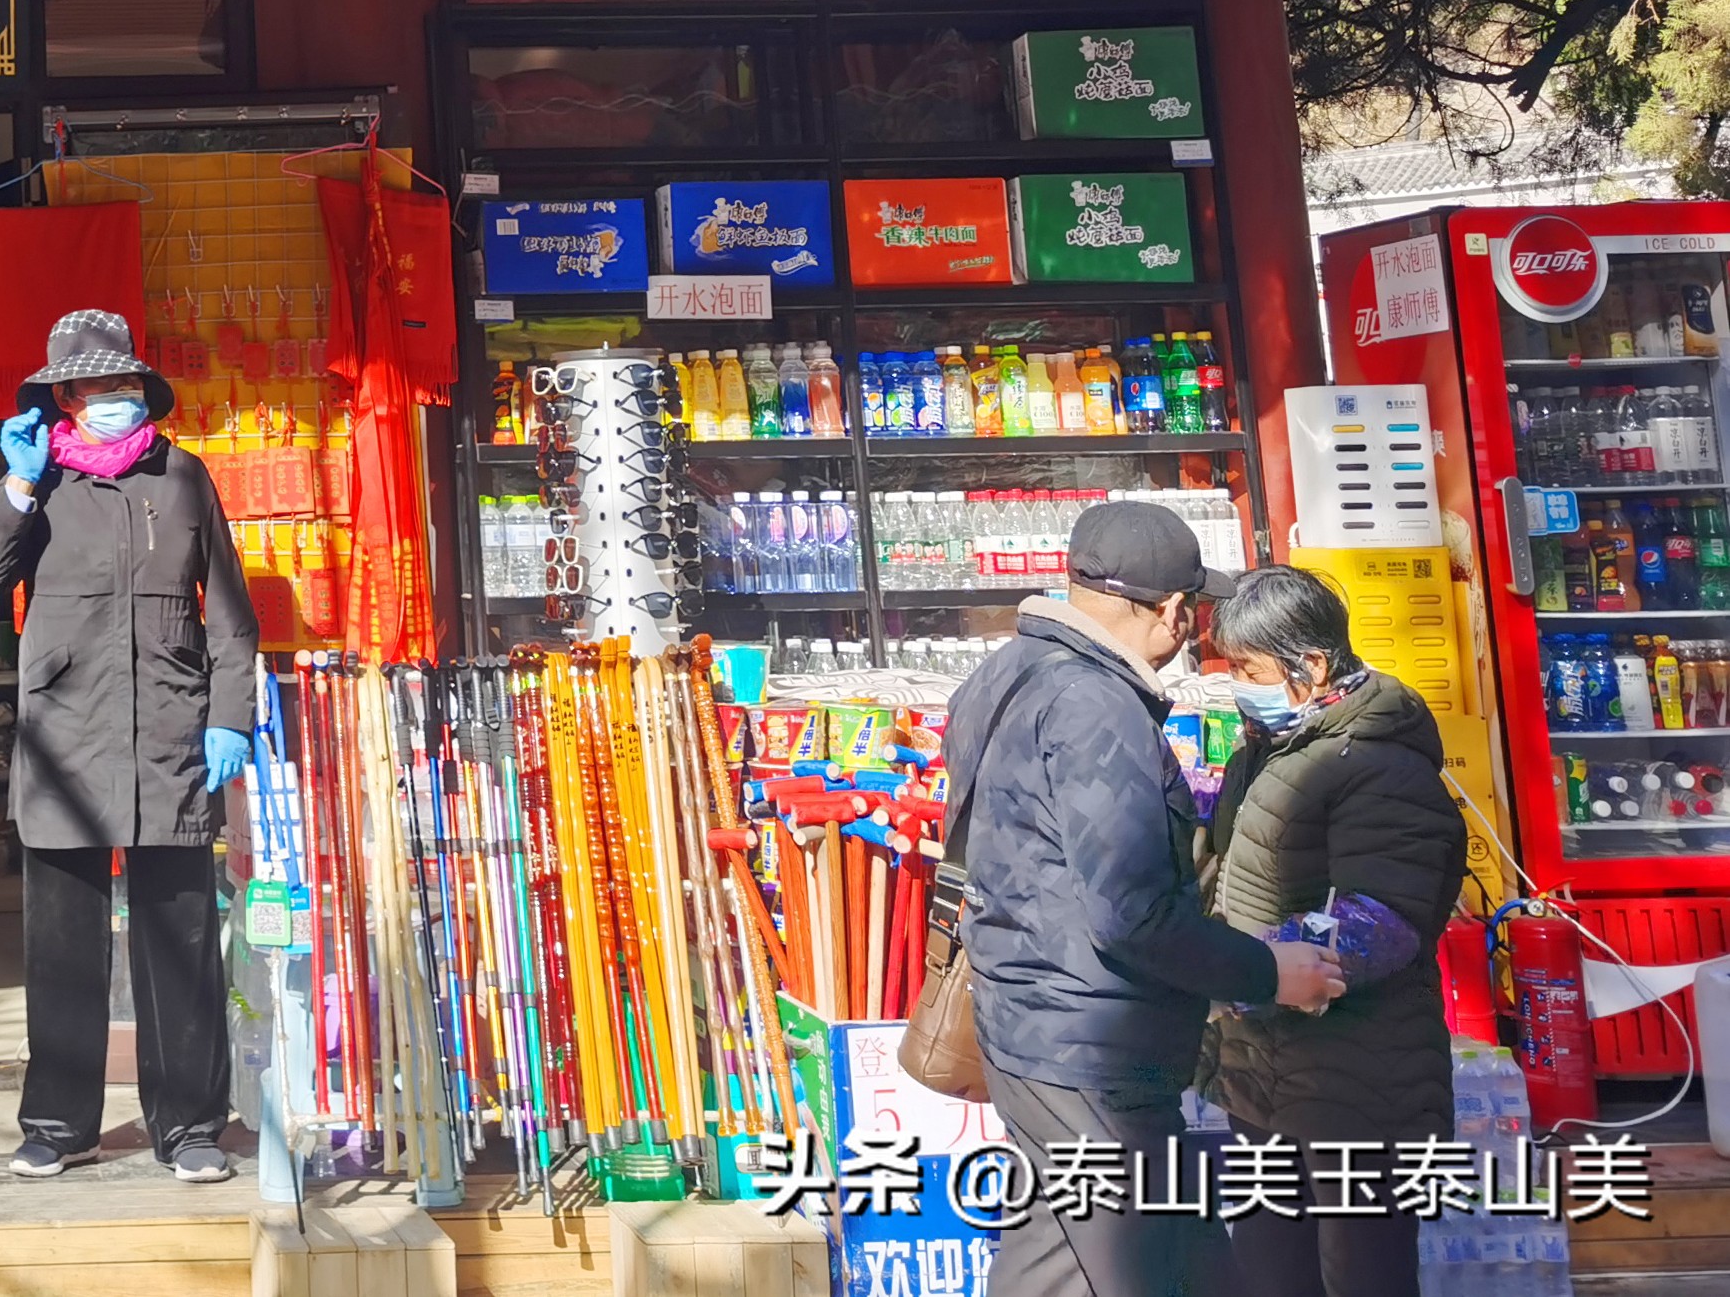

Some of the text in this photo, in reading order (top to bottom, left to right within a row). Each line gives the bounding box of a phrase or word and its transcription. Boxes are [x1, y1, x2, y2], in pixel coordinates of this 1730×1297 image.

[875, 225, 977, 248] 香辣牛肉面
[1645, 237, 1716, 250] ICE COLD
[1375, 239, 1438, 280] 开水泡面
[1512, 248, 1593, 276] 可口可乐
[655, 283, 764, 316] 开水泡面
[1386, 287, 1441, 329] 康师傅
